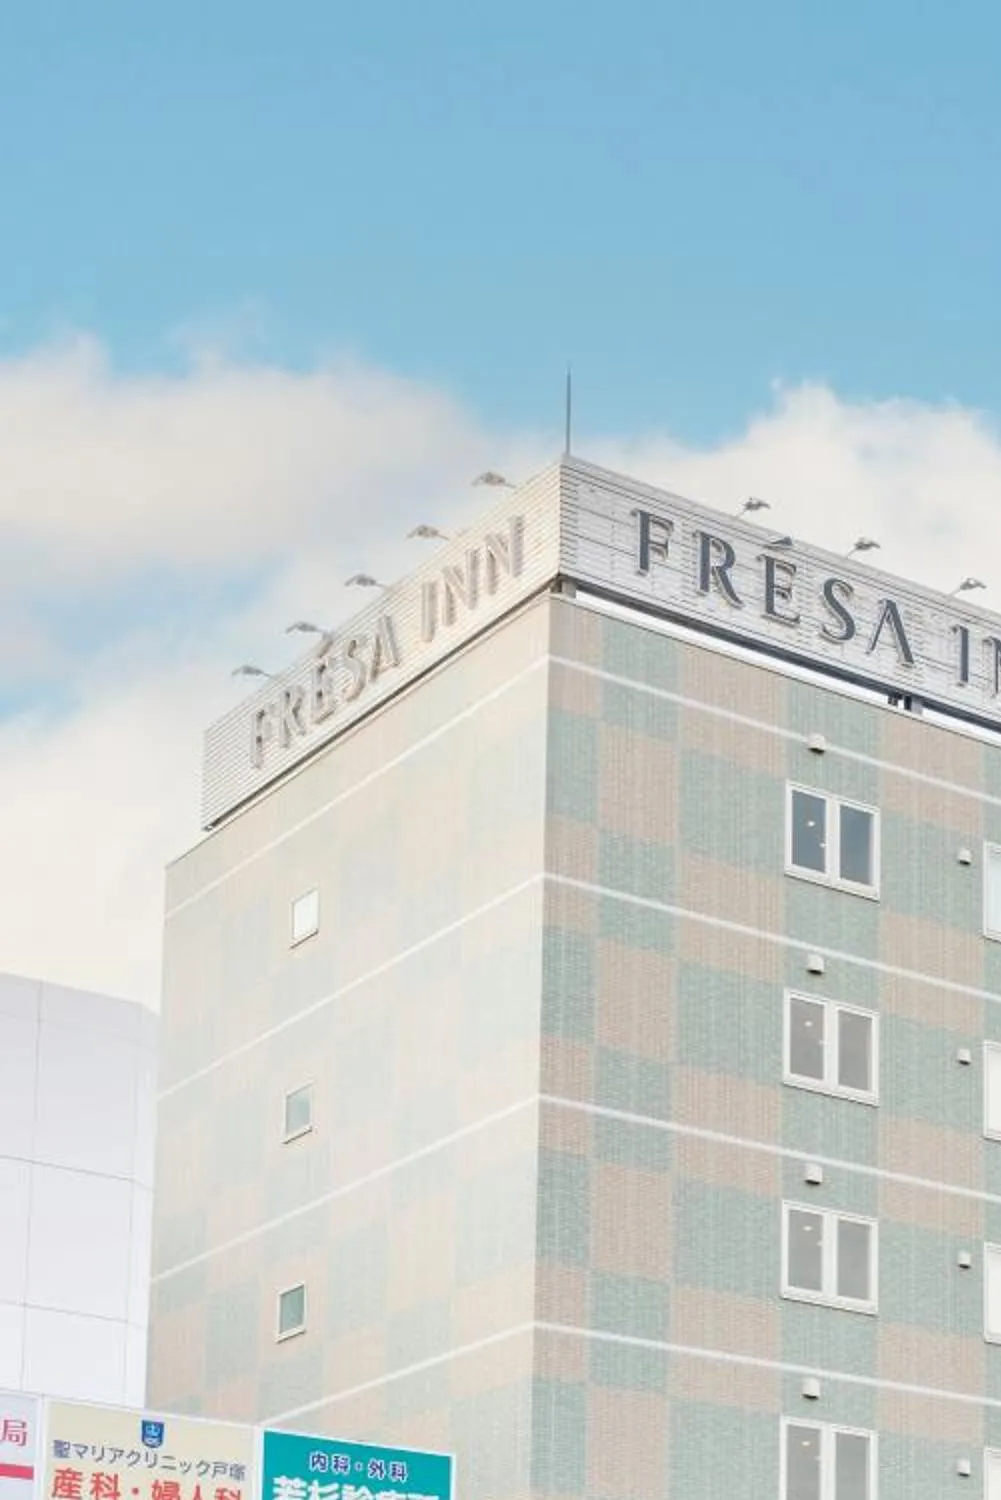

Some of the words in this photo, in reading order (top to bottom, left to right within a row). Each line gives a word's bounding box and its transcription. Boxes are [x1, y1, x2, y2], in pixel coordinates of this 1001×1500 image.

[250, 633, 401, 770] FRÉSA
[420, 514, 525, 643] INN
[630, 508, 914, 666] FRÉSA
[2, 1419, 27, 1446] 局
